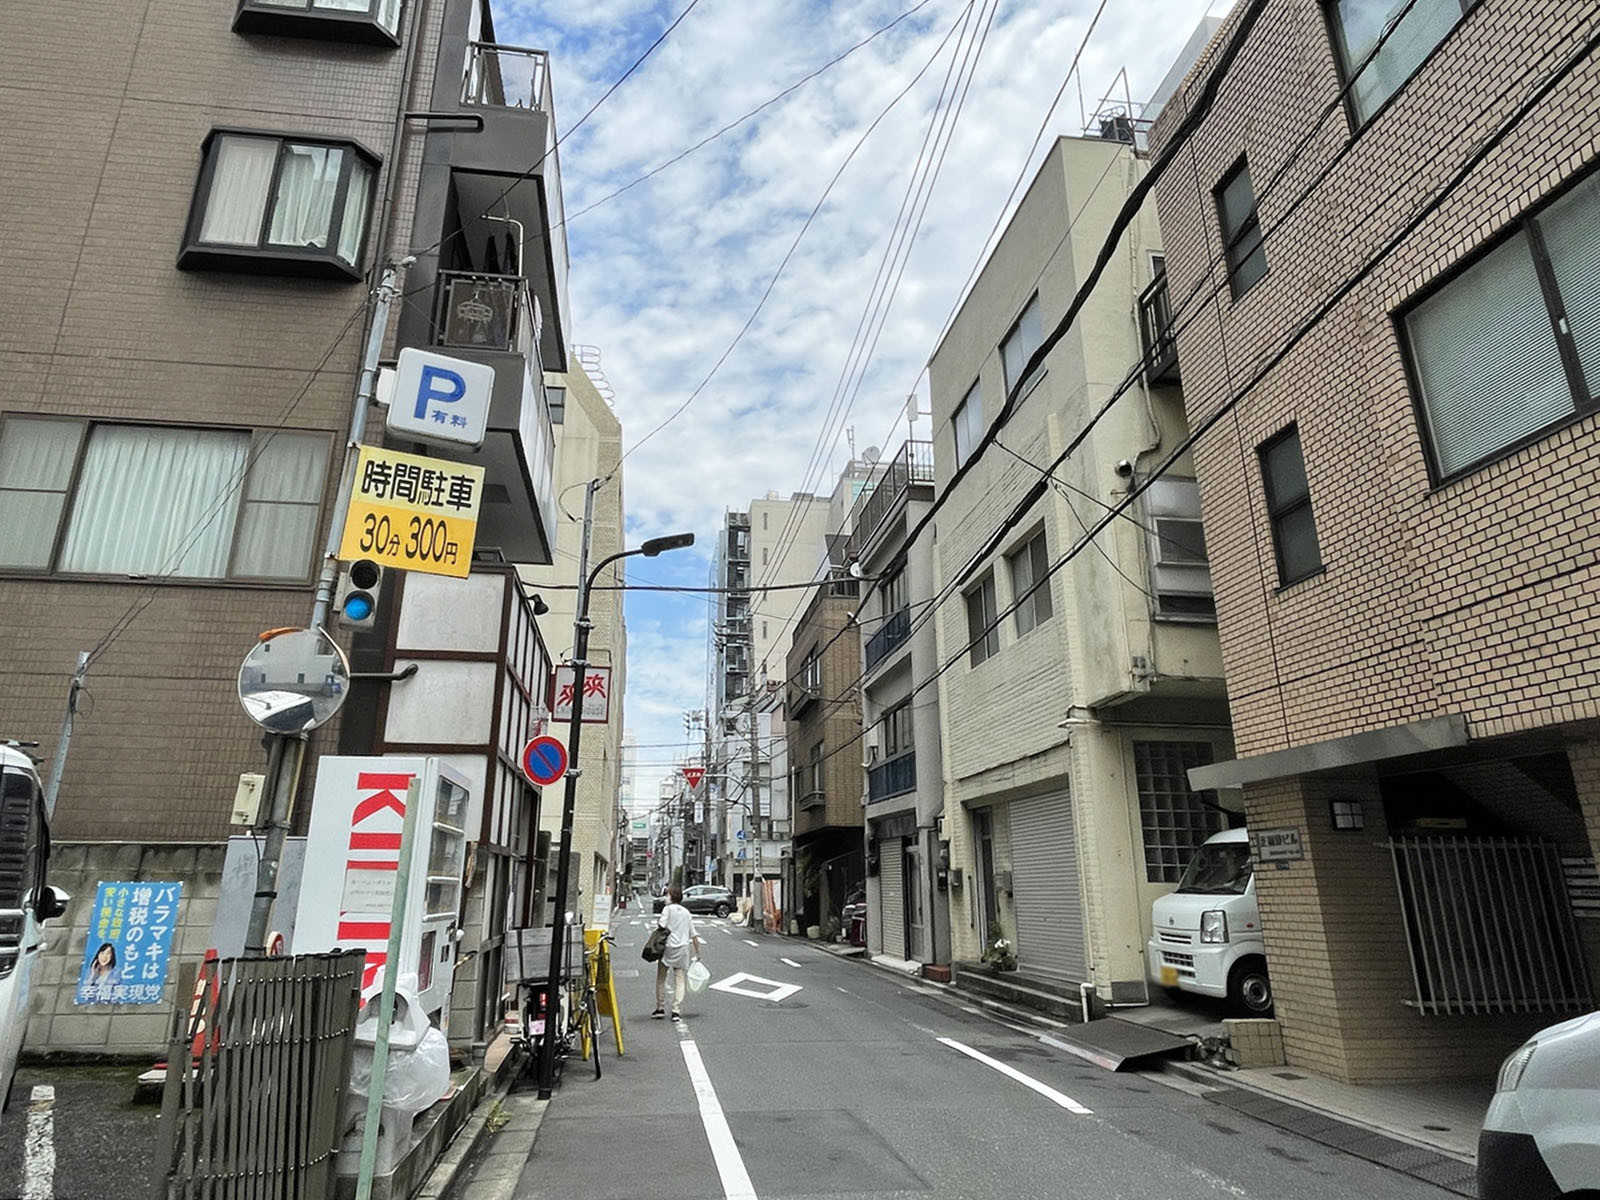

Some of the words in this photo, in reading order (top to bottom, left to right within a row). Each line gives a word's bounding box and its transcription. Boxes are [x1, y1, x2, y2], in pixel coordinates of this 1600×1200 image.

[413, 364, 467, 419] P
[431, 409, 467, 429] 有料
[361, 460, 475, 511] 時間駐車
[360, 512, 401, 557] 30分
[405, 515, 458, 565] 300円
[337, 772, 417, 1008] KII
[121, 887, 152, 979] 増税のもと
[142, 886, 176, 979] バラマキは
[79, 983, 161, 1001] 幸福実現党
